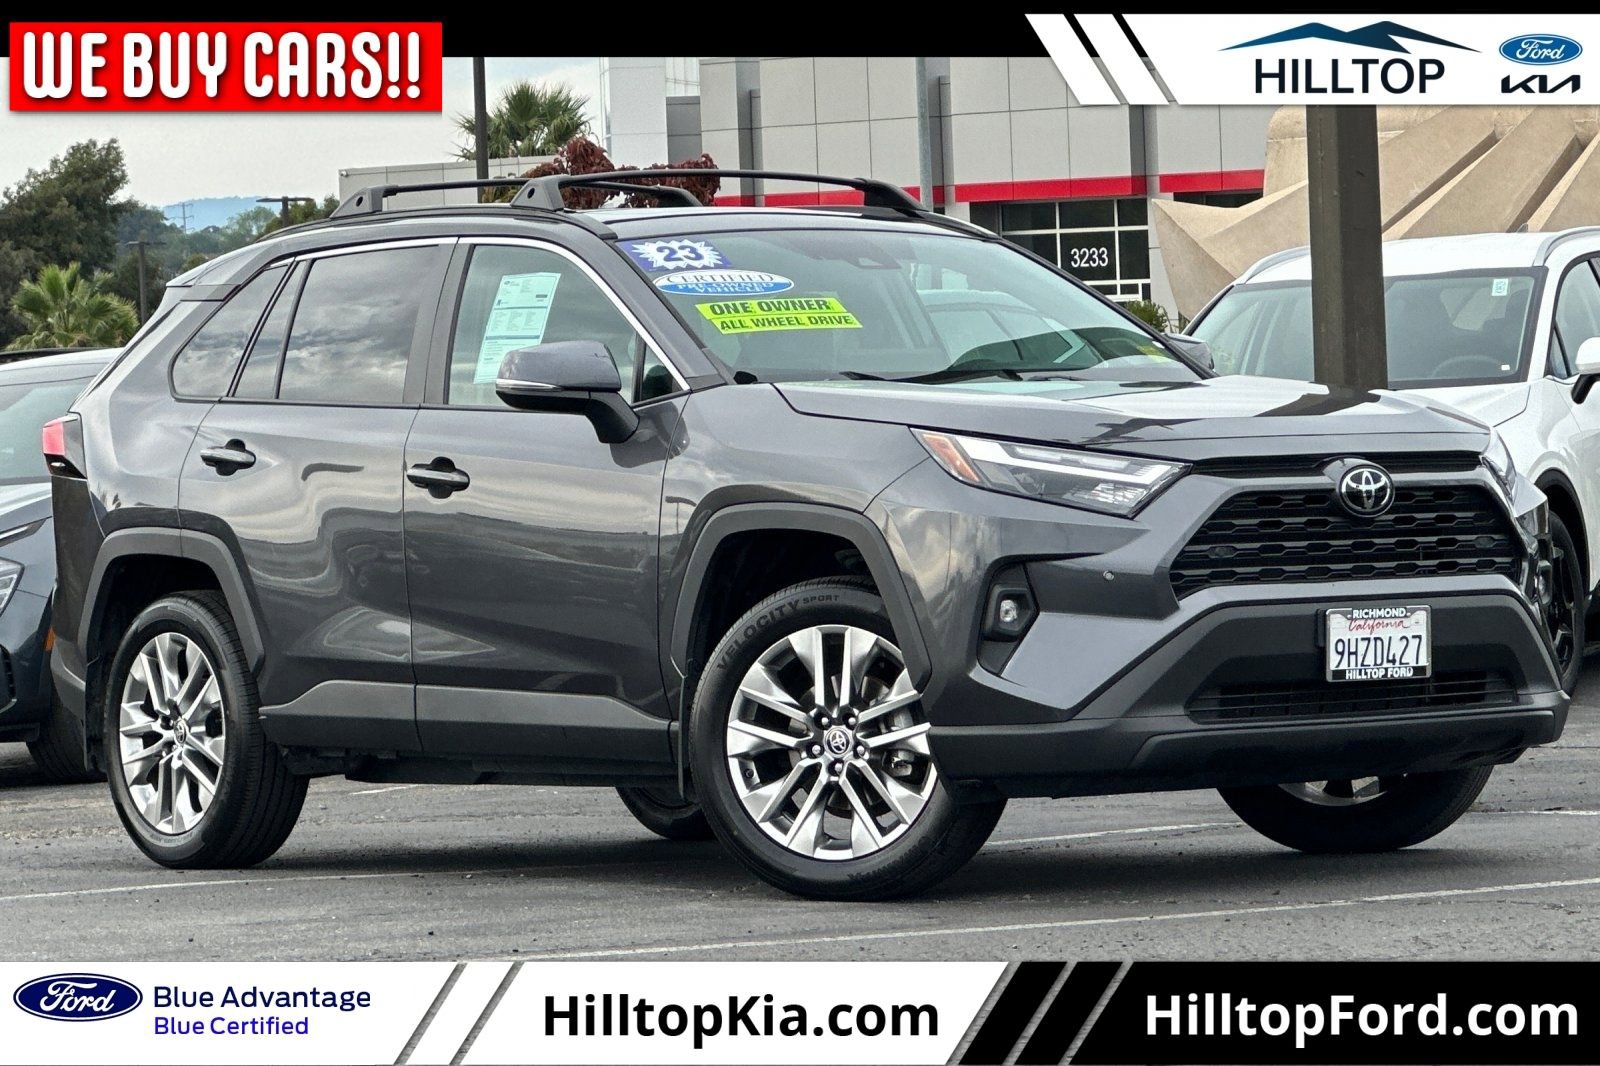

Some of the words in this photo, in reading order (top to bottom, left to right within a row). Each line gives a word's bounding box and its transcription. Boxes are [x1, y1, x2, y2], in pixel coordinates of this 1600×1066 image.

[656, 244, 705, 262] 23
[1070, 247, 1109, 268] 3233
[666, 273, 775, 283] CERTIFIED
[709, 303, 753, 316] ONE
[760, 299, 831, 313] OWNER
[720, 319, 749, 331] ALL
[753, 316, 805, 328] WHEEL
[809, 314, 854, 326] DRIVE
[1352, 607, 1407, 619] RICHMOND
[716, 600, 800, 671] VELOCITY
[802, 594, 841, 604] SPORT
[1349, 618, 1410, 635] California
[1334, 634, 1423, 669] 9HZD427
[1345, 668, 1386, 680] HILLTOP
[1387, 666, 1414, 678] FORD
